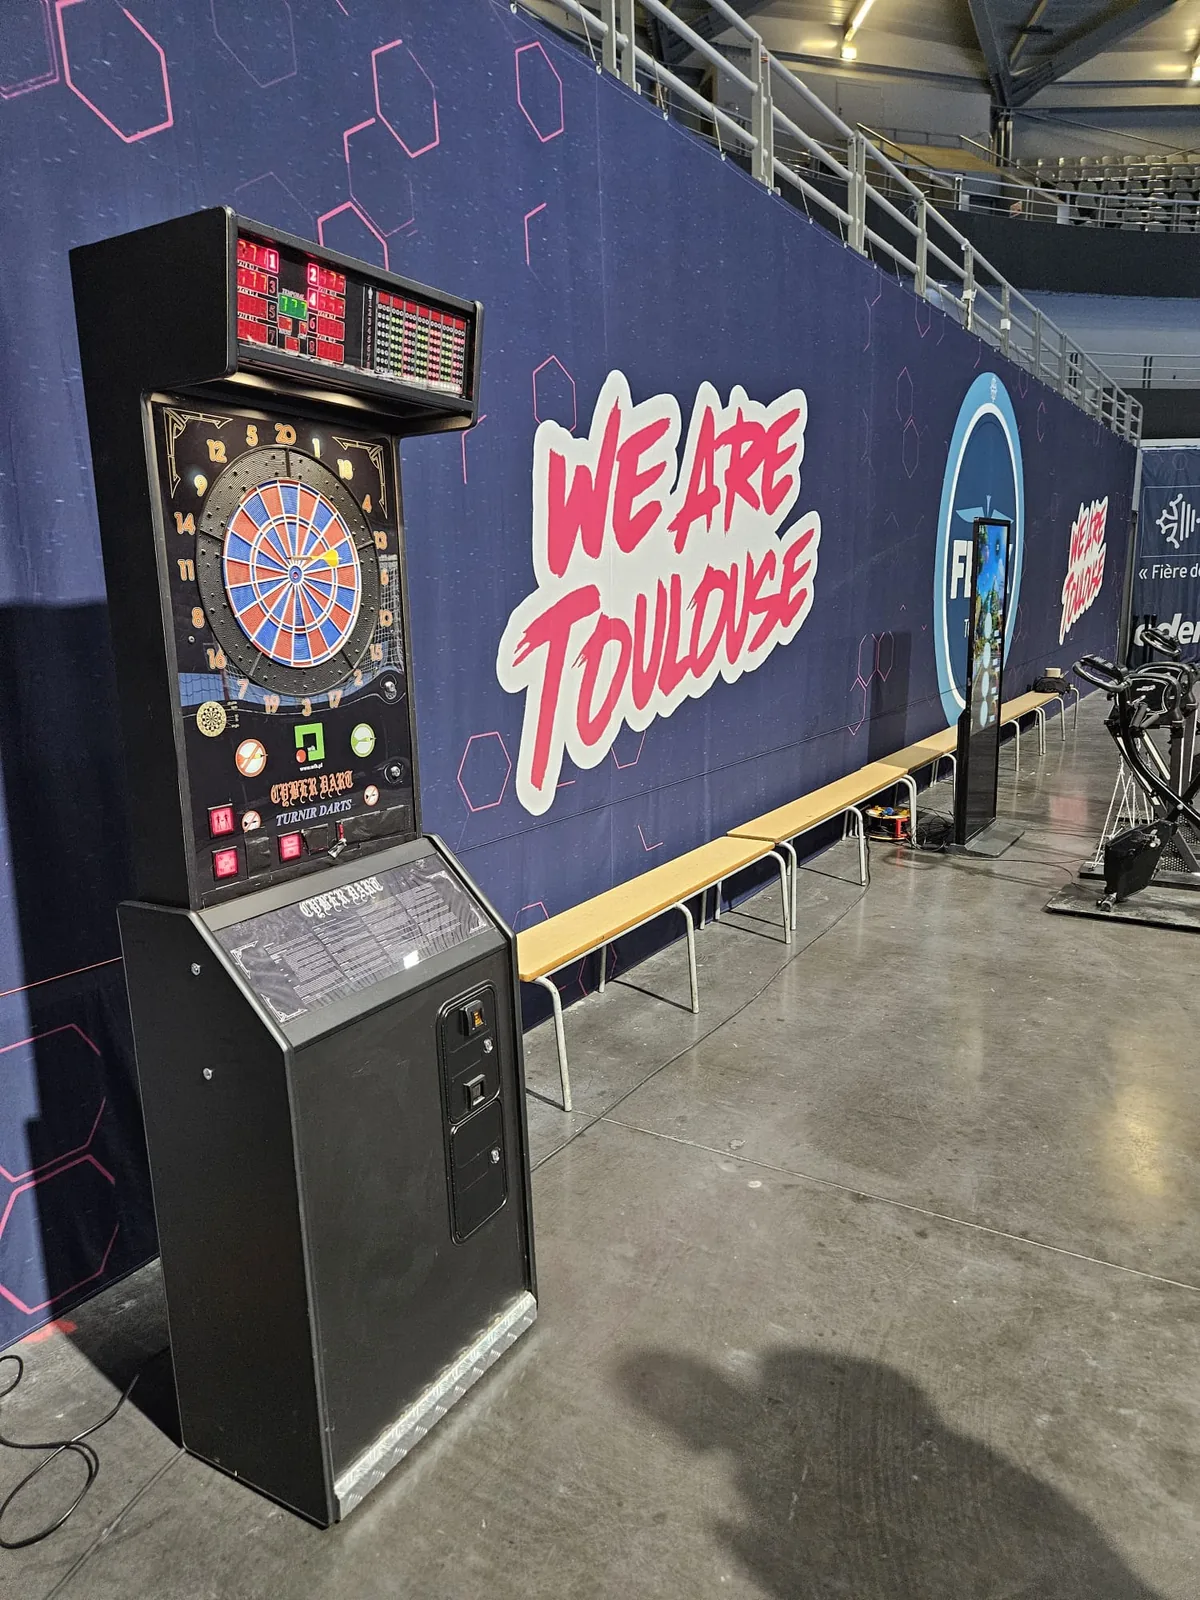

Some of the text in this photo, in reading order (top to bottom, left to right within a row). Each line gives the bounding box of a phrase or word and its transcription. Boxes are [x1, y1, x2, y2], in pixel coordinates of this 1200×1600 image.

[269, 253, 276, 269] 1
[309, 267, 317, 283] 2
[269, 280, 276, 294] 3
[309, 293, 317, 307] 4
[269, 305, 276, 319] 5
[309, 317, 316, 330] 6
[269, 330, 276, 344] 7
[309, 340, 315, 353] 8
[246, 425, 258, 446] 5
[275, 423, 296, 445] 20
[207, 439, 227, 463] 12
[312, 438, 320, 458] 1
[194, 475, 208, 496] 9
[548, 396, 800, 578] WE ARE
[362, 494, 372, 513] 4
[174, 512, 196, 535] 14
[178, 559, 195, 581] 11
[380, 568, 389, 585] 6
[1152, 563, 1188, 579] Fière
[1189, 562, 1200, 578] d
[192, 607, 205, 628] 8
[379, 609, 393, 627] 10
[207, 649, 226, 669] 16
[370, 643, 383, 661] 15
[512, 528, 814, 791] TOULOUSE
[354, 669, 363, 687] 2
[237, 679, 249, 699] 7
[263, 695, 280, 713] 19
[302, 698, 312, 716] 3
[328, 690, 343, 708] 17
[270, 770, 354, 807] CYBER DART
[276, 799, 352, 826] TURNIR DARTS
[299, 877, 383, 918] CYBER DART
